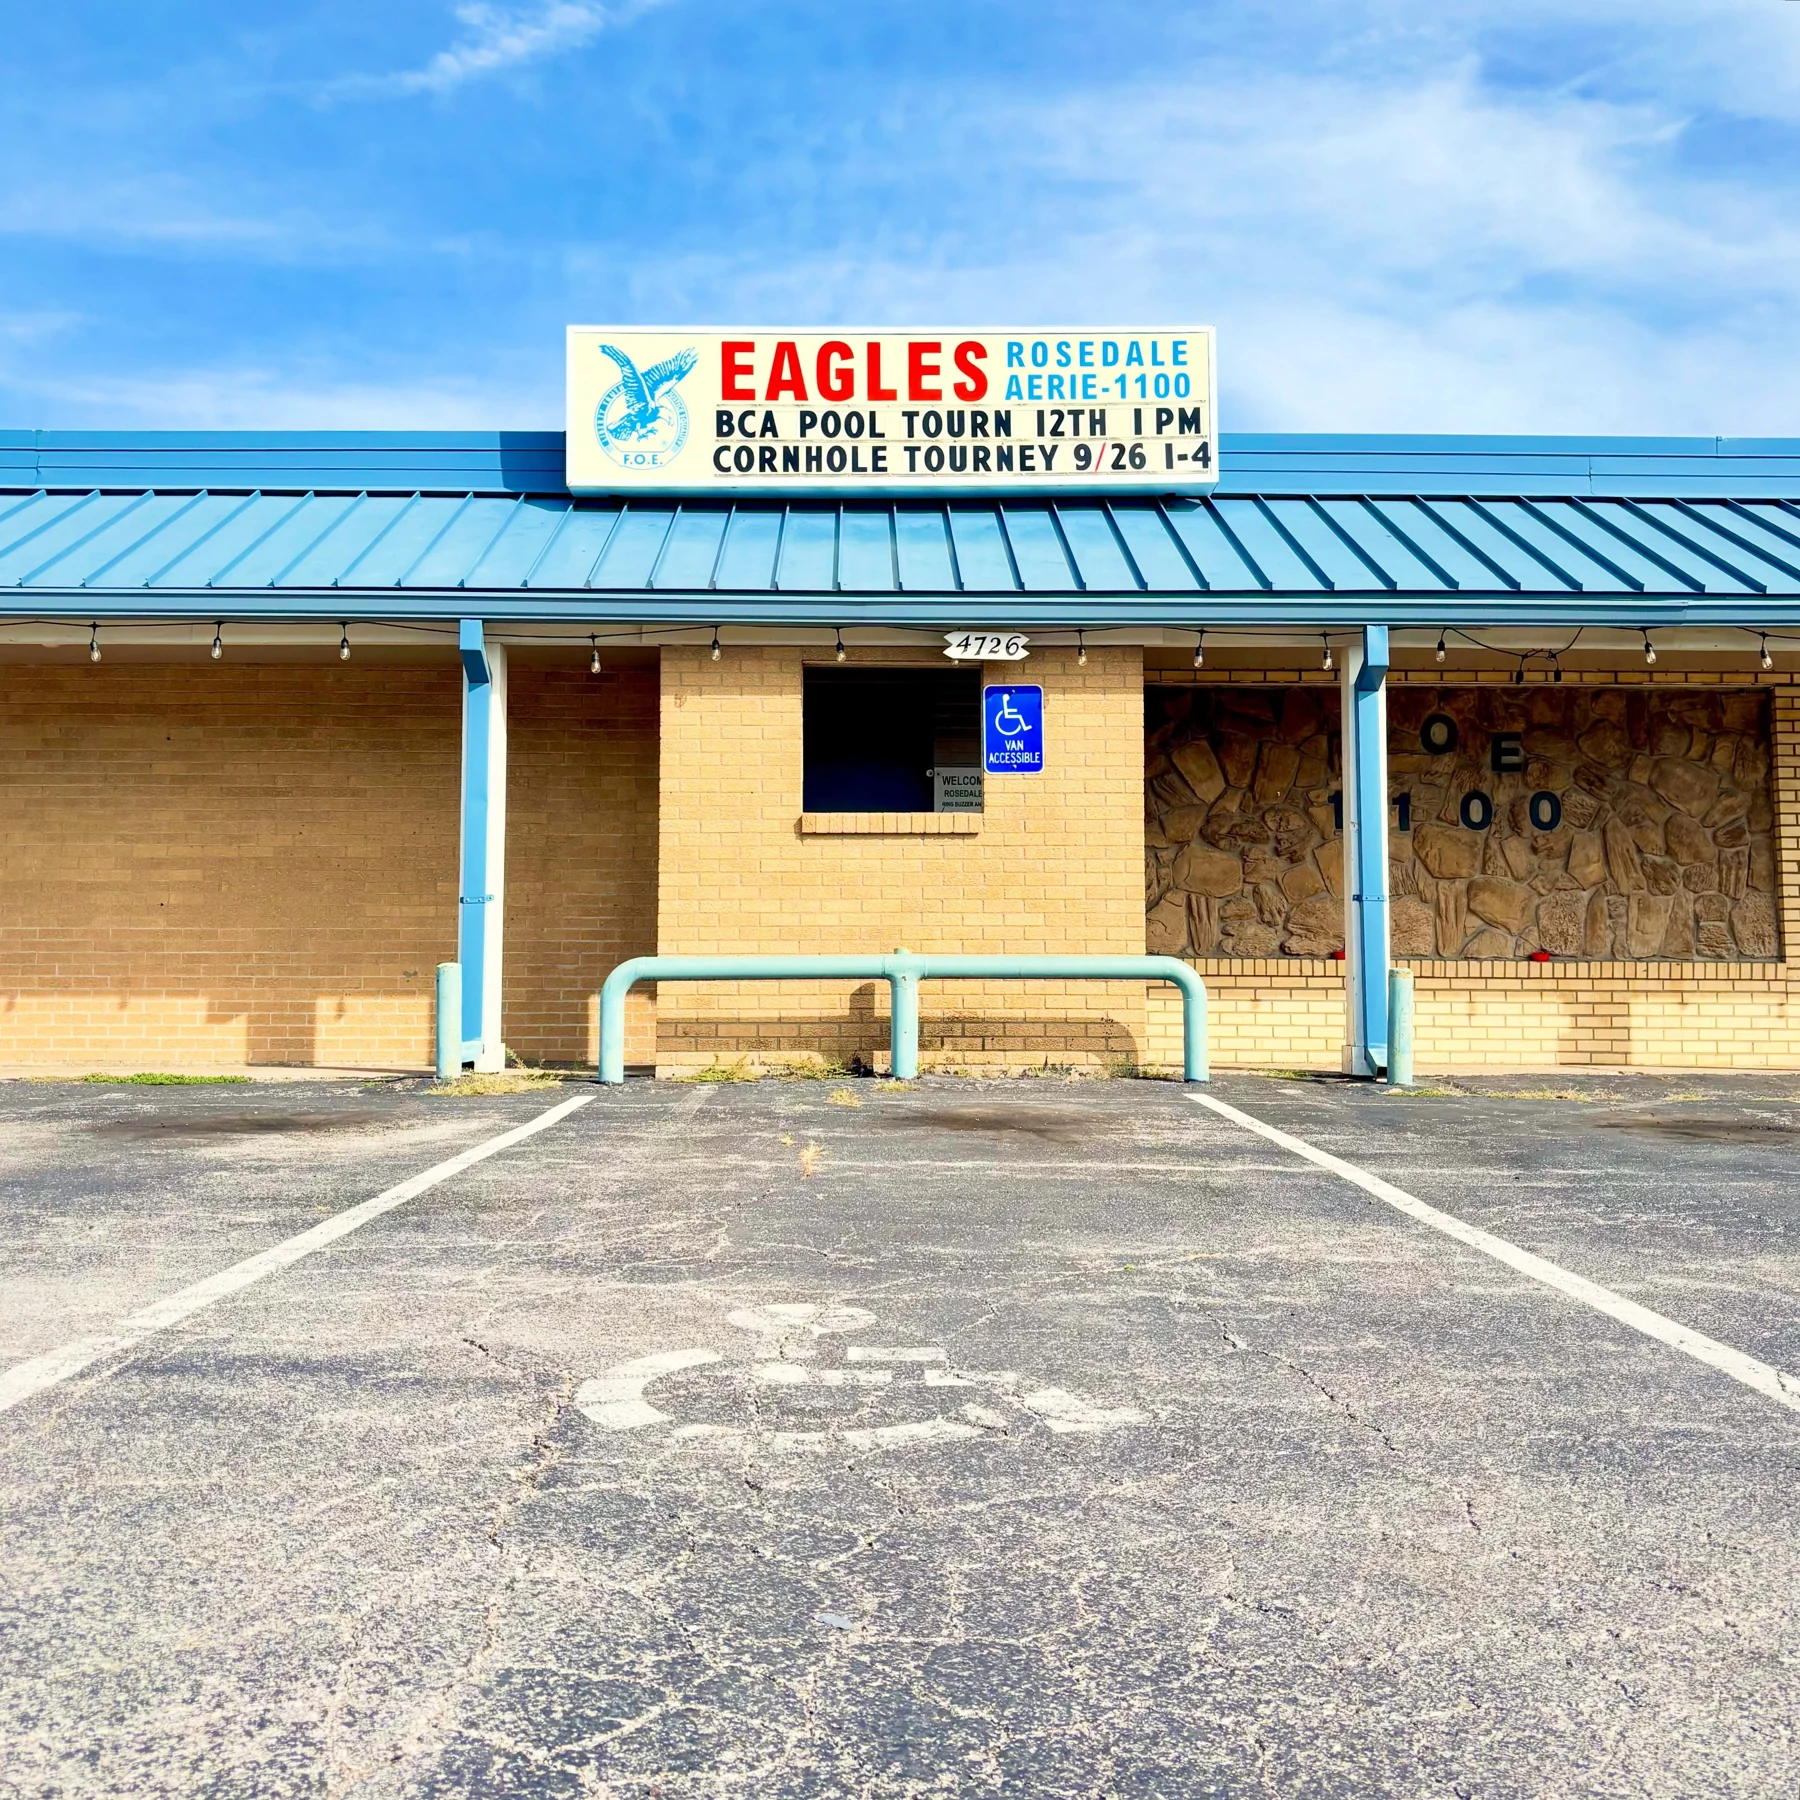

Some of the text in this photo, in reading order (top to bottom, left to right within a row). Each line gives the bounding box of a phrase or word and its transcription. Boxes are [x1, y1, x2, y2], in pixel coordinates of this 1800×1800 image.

[1007, 340, 1188, 368] ROSEDALE
[721, 341, 988, 402] EAGLES
[1005, 372, 1191, 400] AERIE-1100
[716, 410, 779, 439] BCA
[799, 410, 886, 439] POOL
[901, 410, 1012, 439] TOURN
[1036, 409, 1107, 438] 12TH
[623, 453, 663, 465] F.O.E.
[713, 441, 1212, 473] CORNHOLE TOURNEY 9/26 1-4
[955, 634, 1022, 657] 4726
[988, 752, 1041, 764] ACCESSIBLE
[1004, 739, 1025, 752] VAN
[944, 789, 982, 798] ROSEDALE
